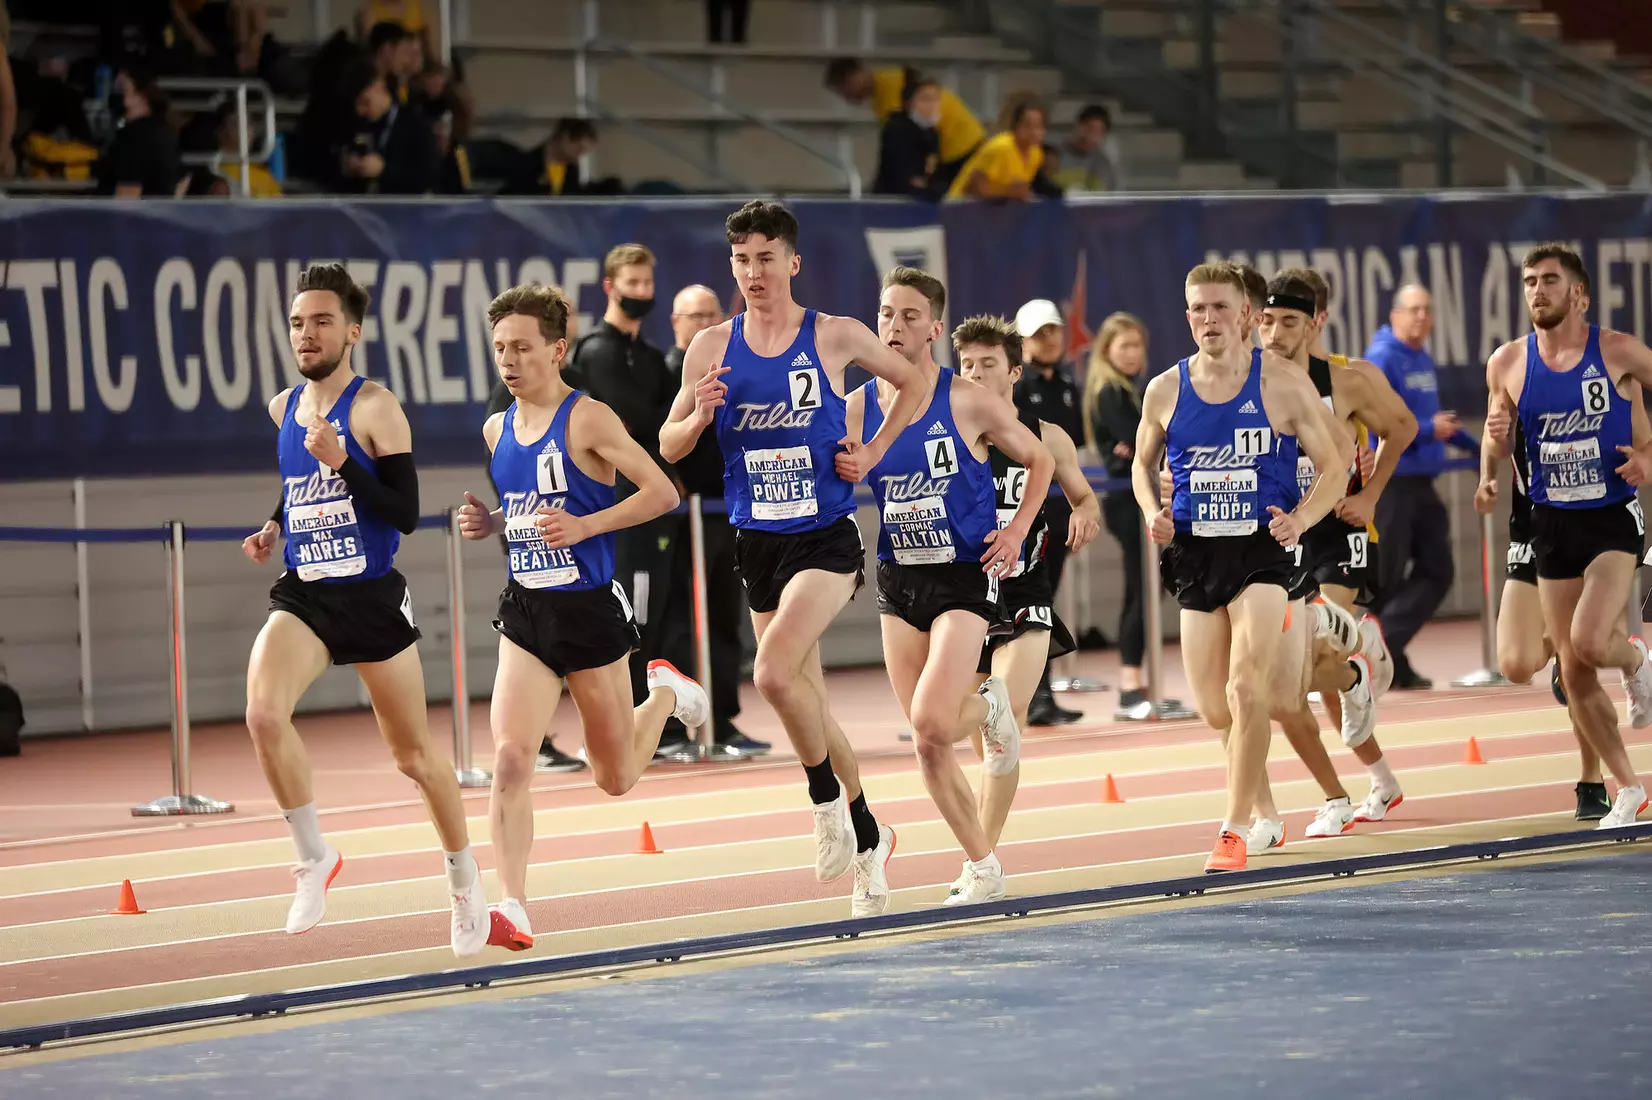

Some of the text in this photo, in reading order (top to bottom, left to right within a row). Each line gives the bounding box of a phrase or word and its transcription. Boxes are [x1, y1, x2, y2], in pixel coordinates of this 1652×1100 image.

[1204, 242, 1469, 366] RICN
[154, 256, 599, 413] CONERENE
[791, 359, 812, 367] adidas
[795, 372, 816, 408] 2
[1588, 382, 1605, 411] 8
[733, 401, 815, 431] Tulsa
[1538, 409, 1604, 438] Tulsa
[926, 428, 947, 436] adidas
[1241, 430, 1262, 454] 11
[750, 458, 808, 472] AMERICAN
[933, 441, 953, 473] 4
[1183, 444, 1257, 469] Tulsa
[1542, 447, 1596, 462] AMERICAN
[544, 456, 558, 491] 1
[762, 471, 799, 484] MICHAEL
[1550, 470, 1599, 487] AKERS
[284, 470, 349, 508] Tulsa
[753, 480, 814, 501] POWER
[880, 471, 952, 501] Tulsa
[1011, 470, 1025, 502] 6
[1193, 480, 1252, 492] AMERICAN
[503, 489, 567, 519] Tulsa
[1210, 493, 1239, 503] MALTE
[292, 511, 352, 531] AMERICAN
[886, 507, 942, 522] AMERICAN
[1198, 502, 1251, 520] PROPP
[312, 530, 334, 543] MAX
[508, 527, 542, 541] AMERI
[899, 519, 934, 533] CORMAC
[299, 537, 357, 563] NORES
[890, 528, 952, 549] DALTON
[1354, 535, 1363, 565] 9
[510, 548, 576, 571] BEATTIE
